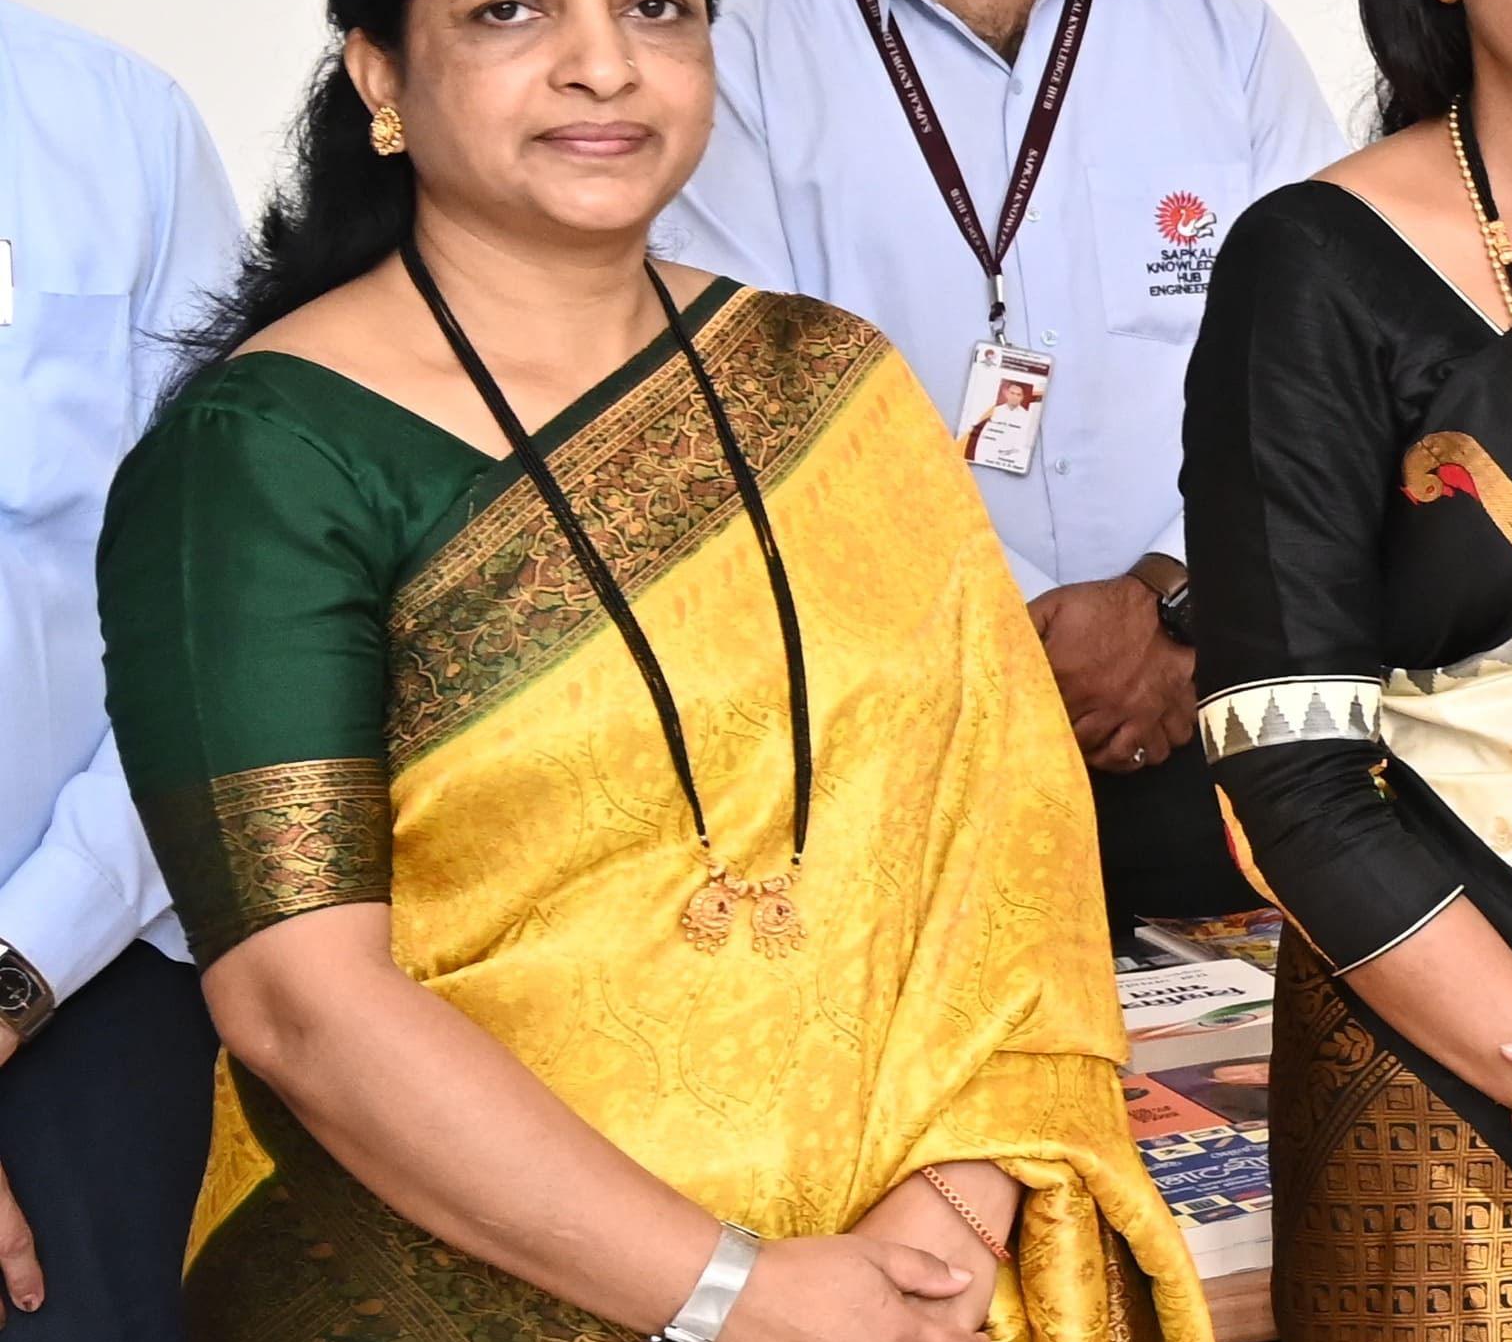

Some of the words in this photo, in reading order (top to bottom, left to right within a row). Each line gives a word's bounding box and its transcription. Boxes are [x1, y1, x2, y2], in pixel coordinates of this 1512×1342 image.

[881, 31, 915, 91] KNOWLED
[1053, 15, 1079, 83] KNOWLEDGE
[906, 88, 933, 134] SAPKAL
[1041, 83, 1060, 111] HUB
[1015, 147, 1040, 190] SAPKAL
[949, 187, 969, 216] HUB
[1146, 260, 1215, 274] KNOWLED
[1160, 248, 1217, 260] SAPKAL
[1177, 271, 1202, 283] HUB
